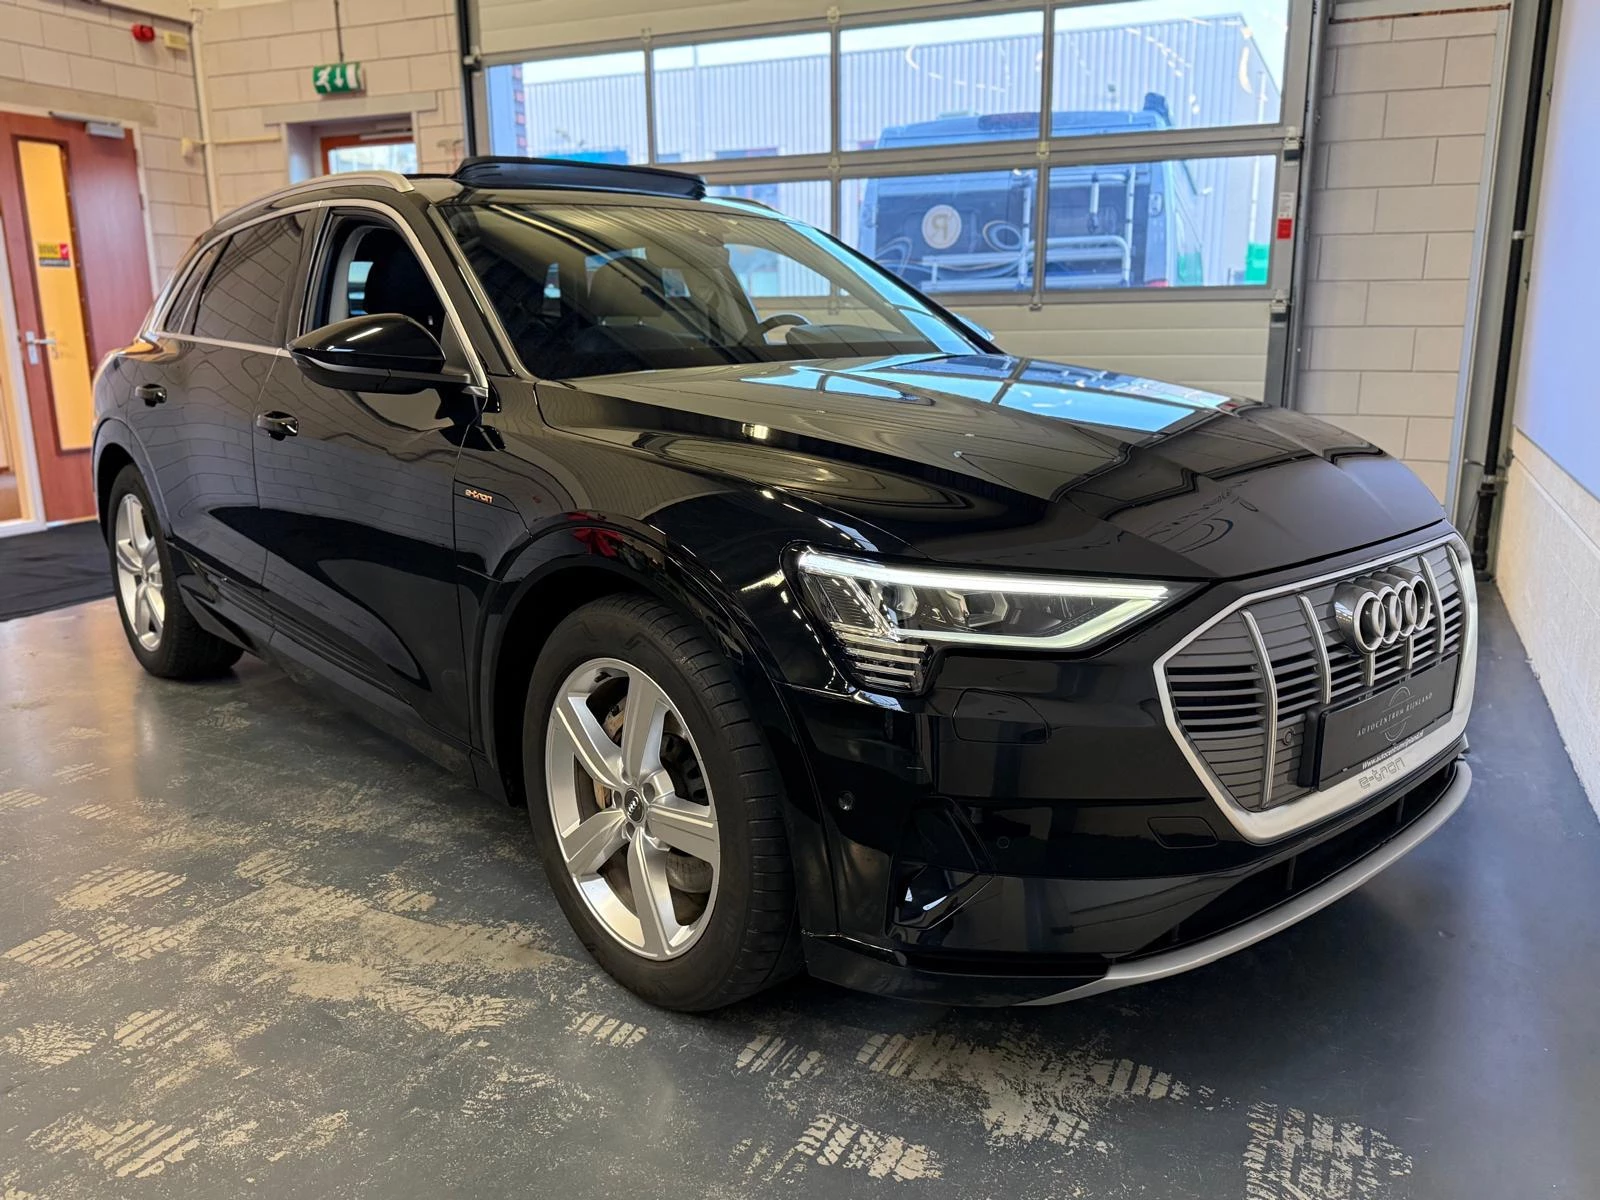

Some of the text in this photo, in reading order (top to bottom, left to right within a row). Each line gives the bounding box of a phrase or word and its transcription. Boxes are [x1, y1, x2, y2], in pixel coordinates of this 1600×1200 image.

[465, 489, 493, 504] e-tron
[1357, 692, 1433, 737] AUTOCENTRUM RIJNLAND
[1359, 757, 1405, 788] e-tron
